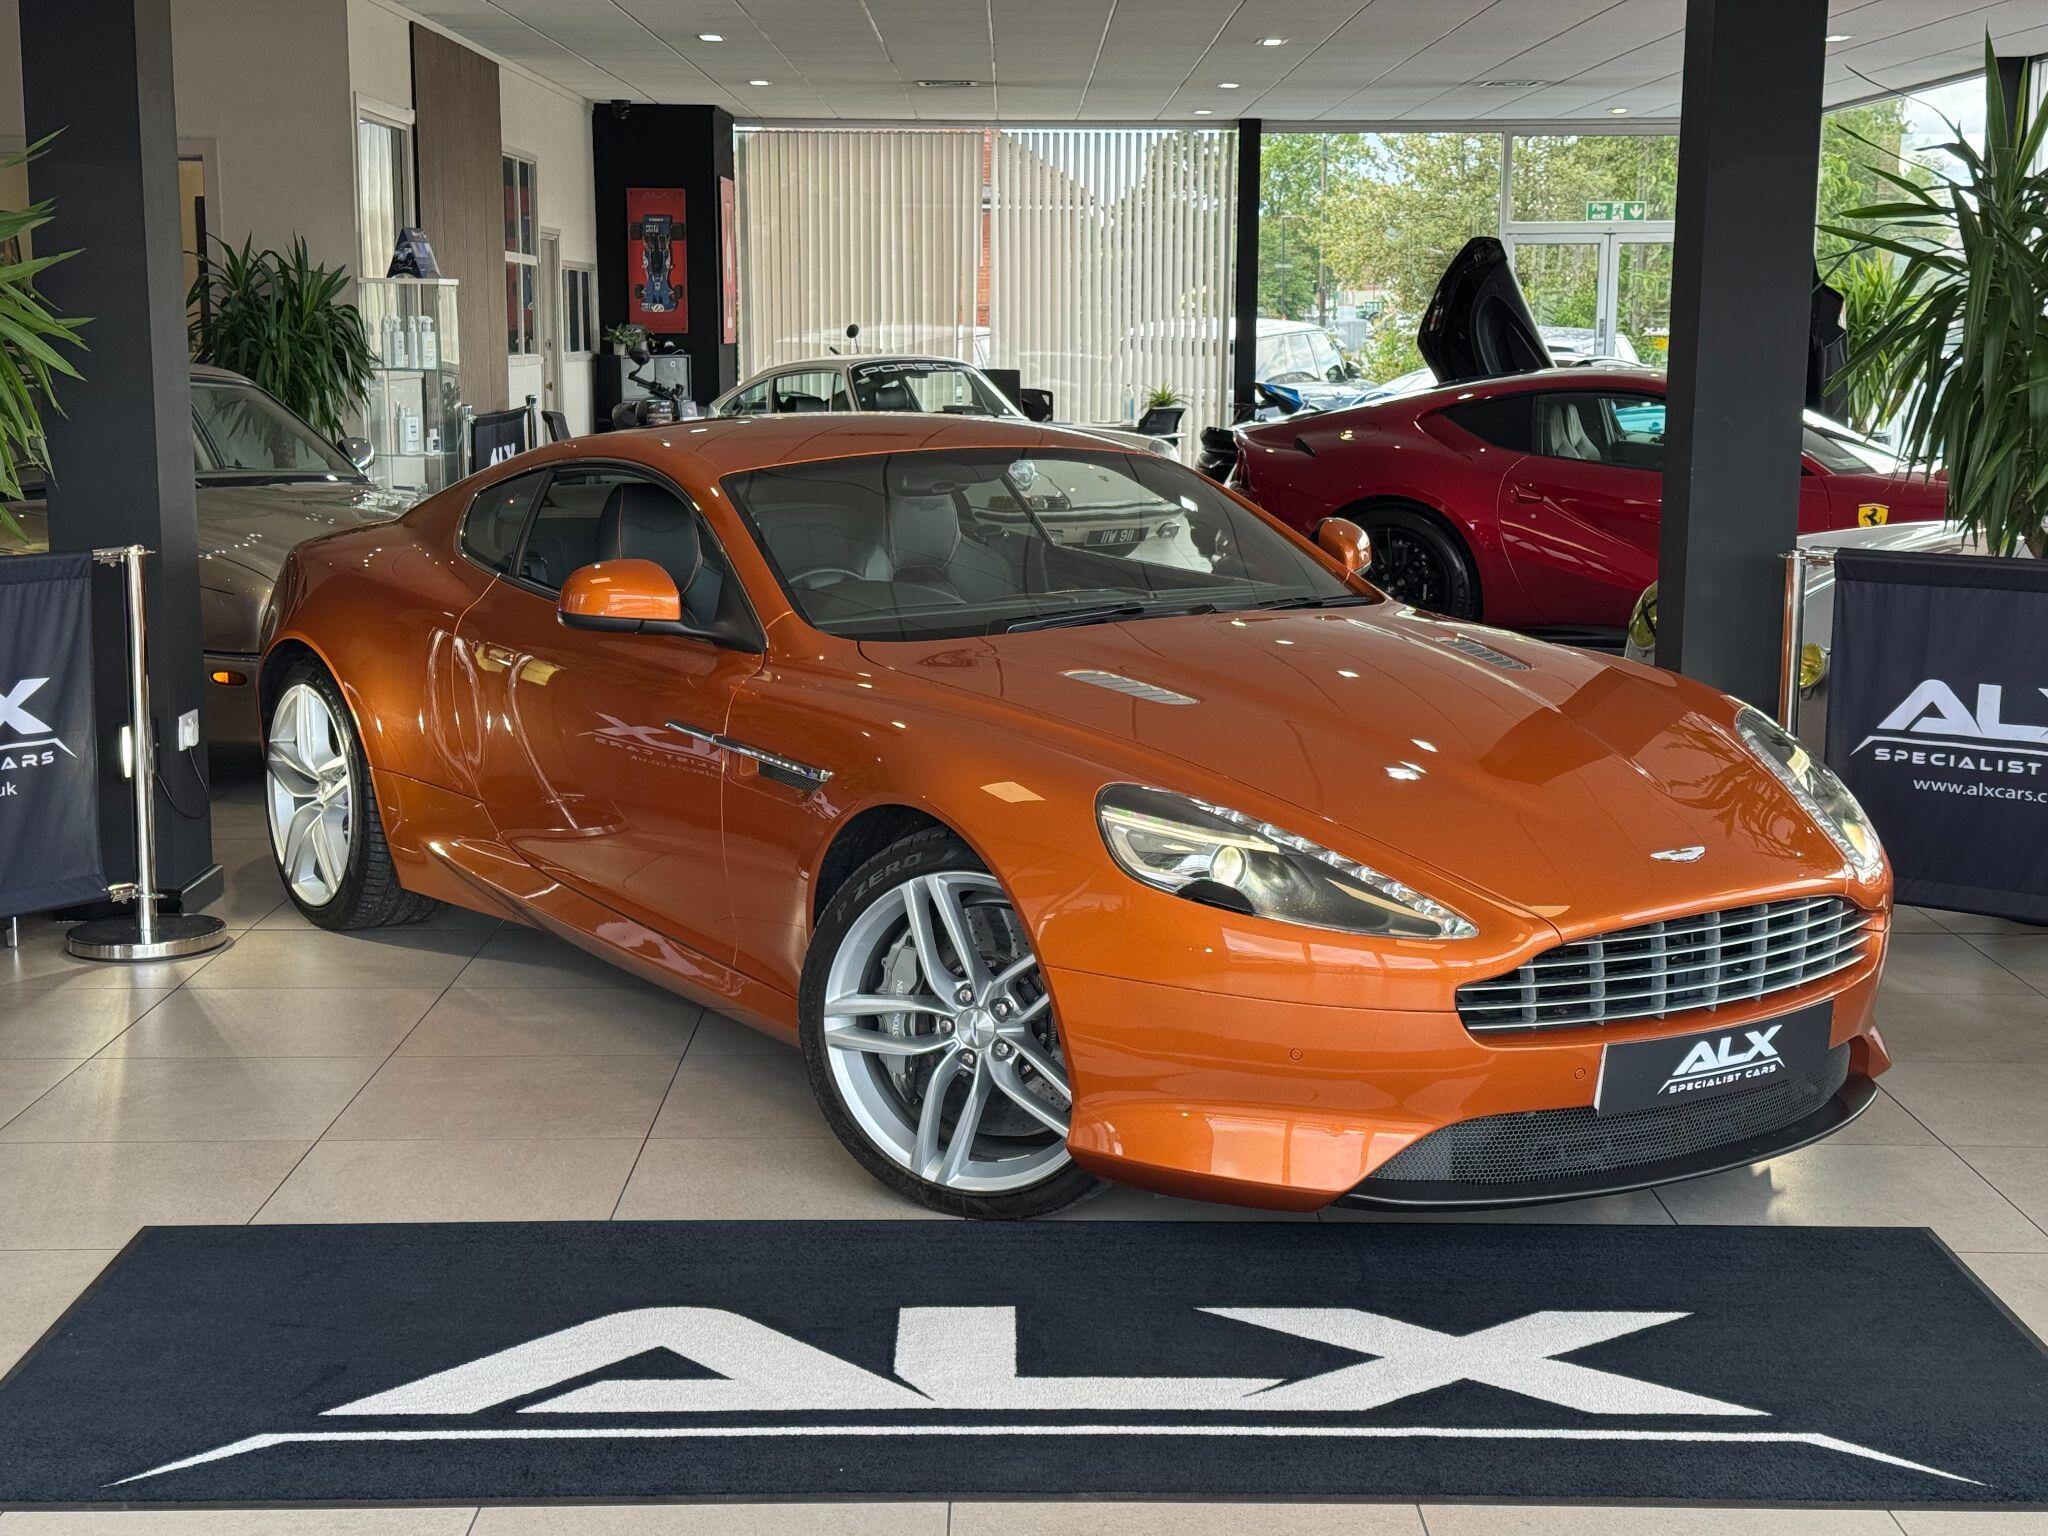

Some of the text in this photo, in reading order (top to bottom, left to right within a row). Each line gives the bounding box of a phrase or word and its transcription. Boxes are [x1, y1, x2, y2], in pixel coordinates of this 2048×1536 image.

[1876, 678, 2048, 744] AL
[0, 750, 55, 770] ARS
[1874, 748, 2042, 776] SPECIALIST
[1913, 779, 2048, 804] www.alxcars.c
[852, 852, 922, 903] ZERO
[891, 1013, 901, 1037] STON
[1672, 1024, 1783, 1077] ALX
[1668, 1064, 1777, 1095] SPECIALIST CARS
[318, 1305, 1773, 1417] ALX
